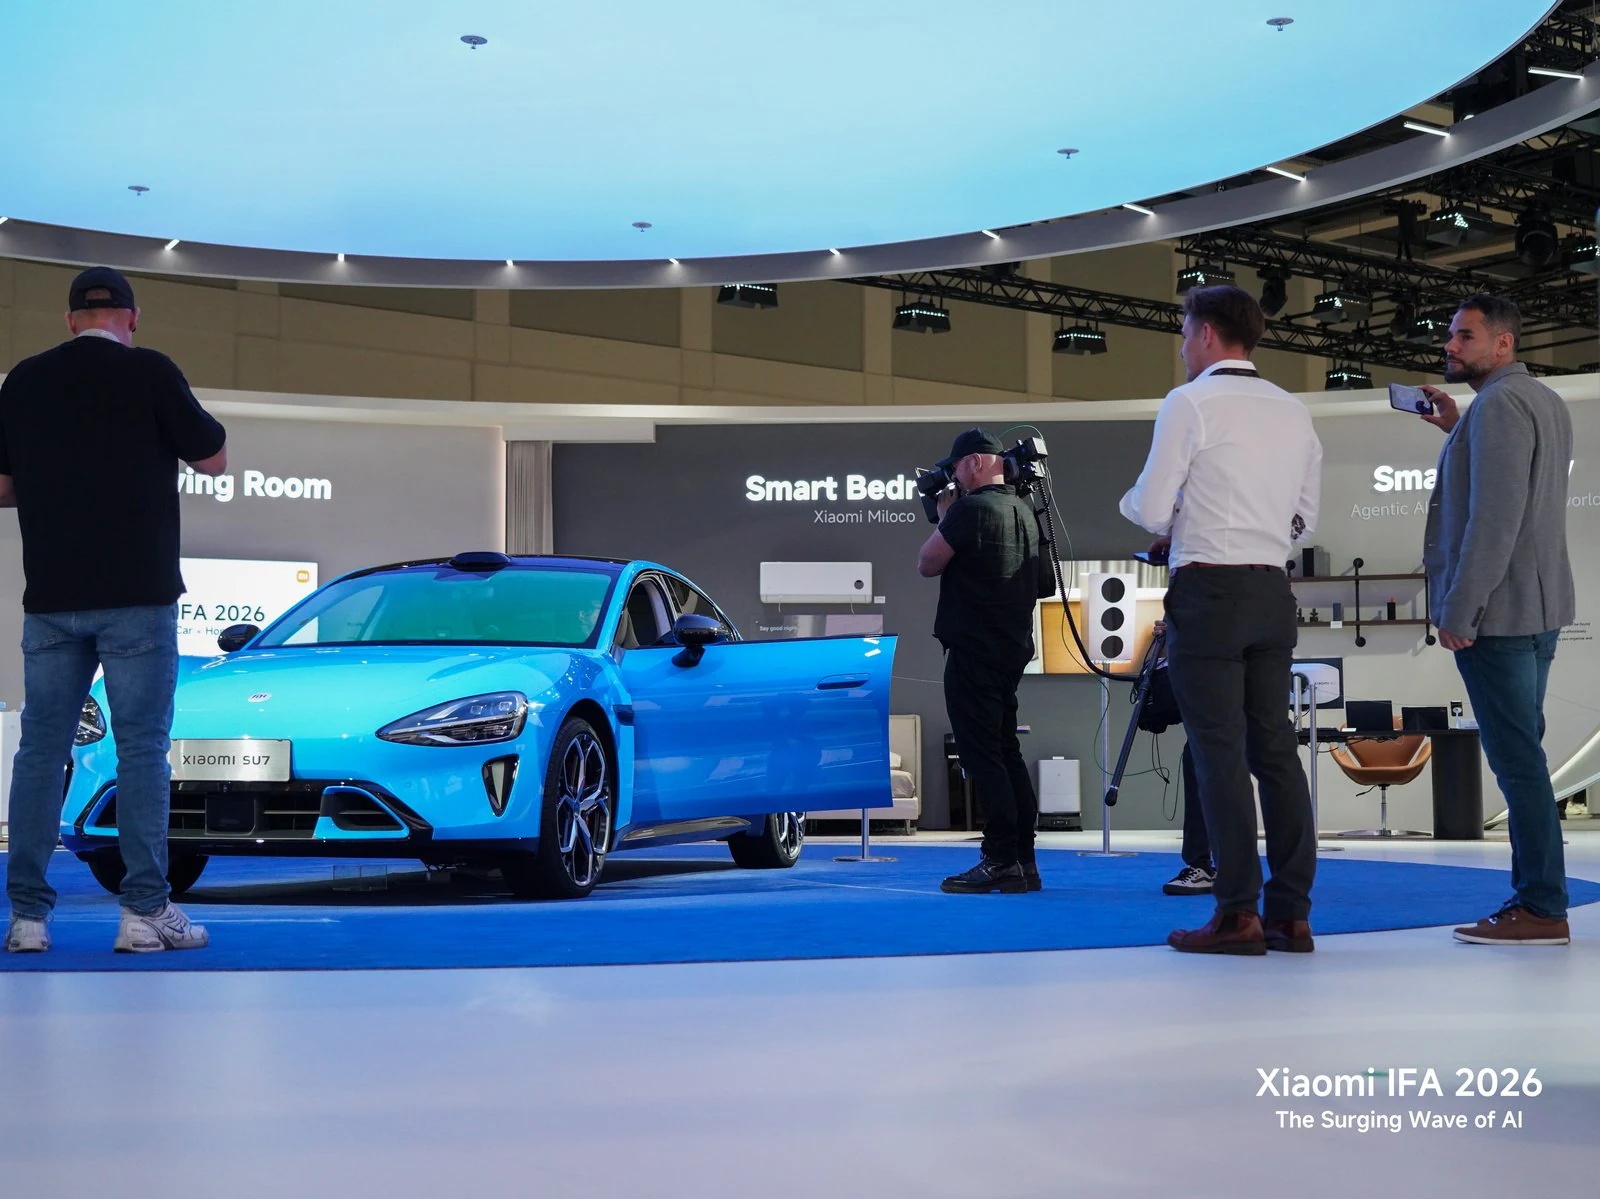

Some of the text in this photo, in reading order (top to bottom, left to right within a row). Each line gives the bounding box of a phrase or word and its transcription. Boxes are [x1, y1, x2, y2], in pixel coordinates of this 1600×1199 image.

[243, 470, 332, 500] Room
[745, 475, 838, 501] Smart
[814, 510, 916, 523] Xiaomi Miloco
[1350, 503, 1408, 520] Agentic
[1413, 500, 1429, 517] AI
[215, 605, 265, 622] 2026
[243, 755, 271, 765] SU7
